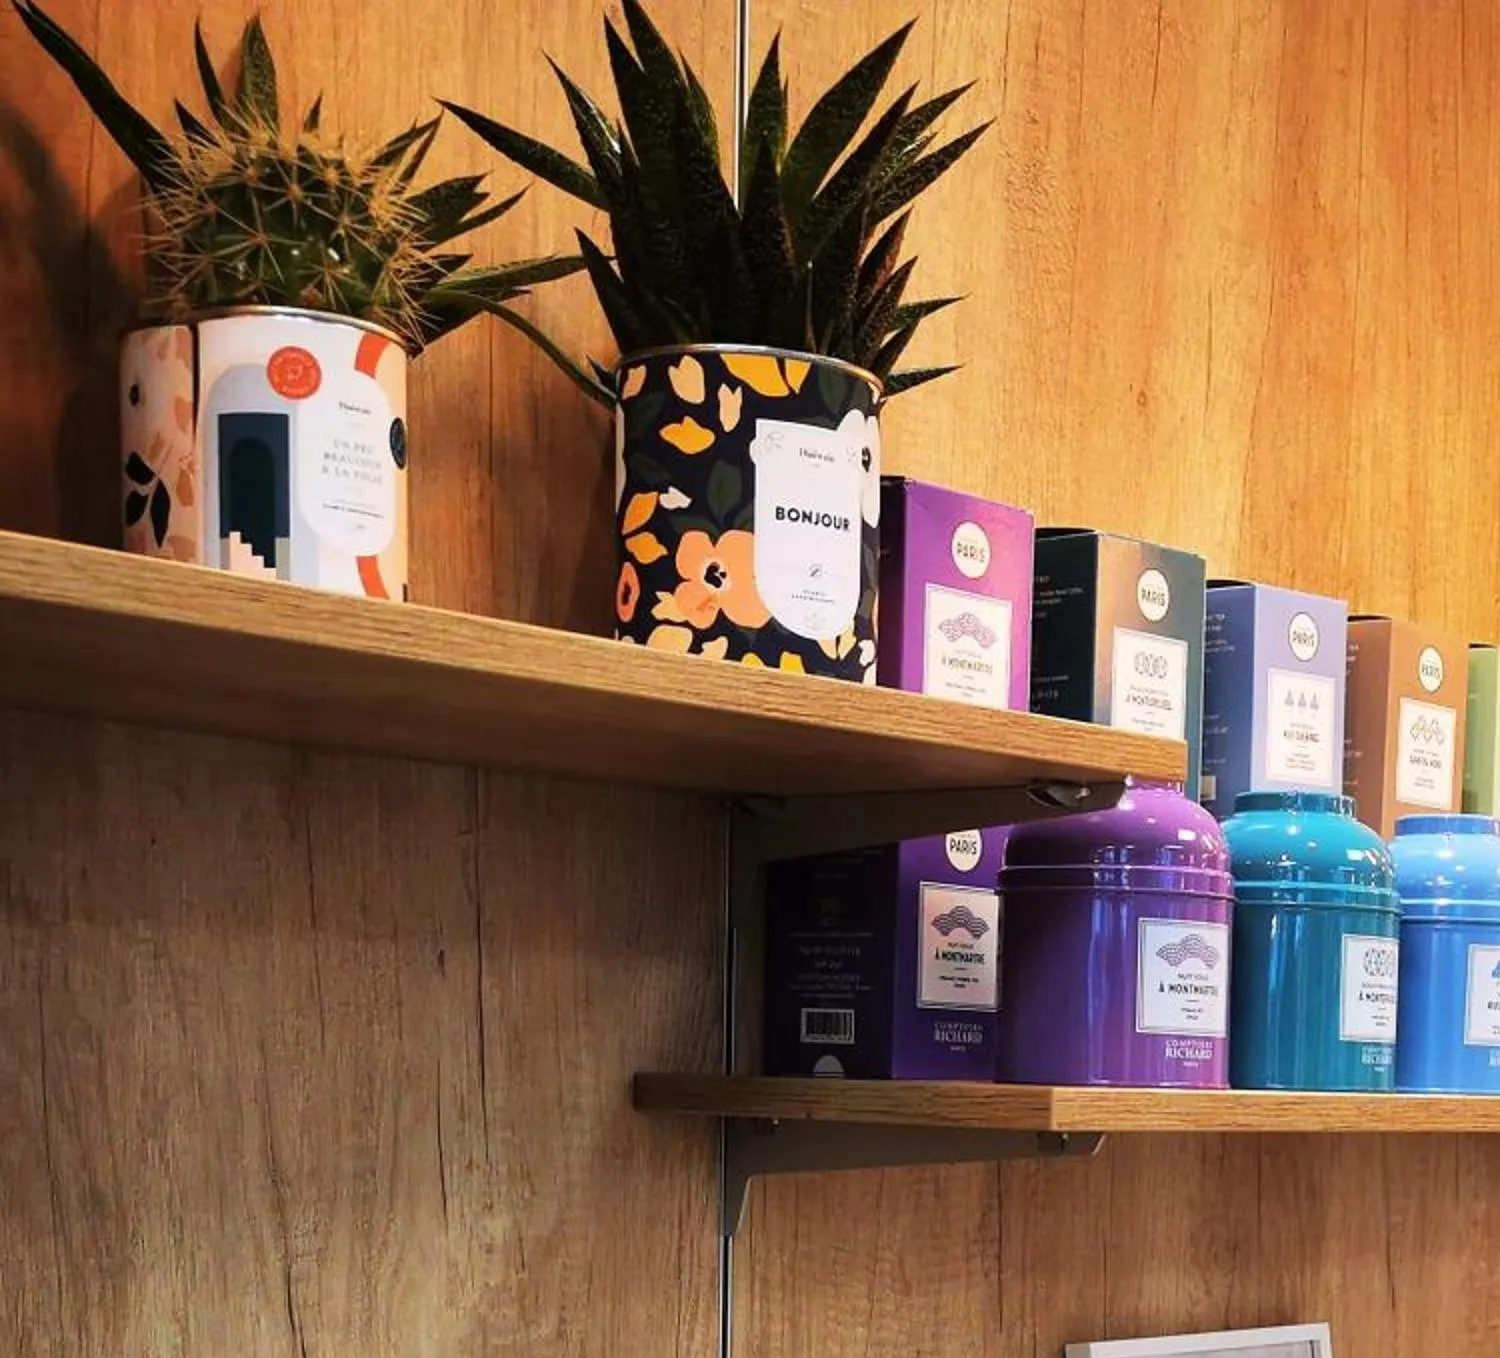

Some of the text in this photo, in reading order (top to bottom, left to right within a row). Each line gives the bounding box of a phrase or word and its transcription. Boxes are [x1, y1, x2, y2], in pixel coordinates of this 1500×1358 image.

[775, 506, 850, 531] BONJOUR
[957, 541, 985, 563] PARIS
[1140, 588, 1166, 607] PARIS
[1292, 630, 1315, 647] PARIS
[950, 839, 977, 855] PARIS
[942, 951, 986, 965] MONTMARTRE
[1168, 983, 1218, 997] MONTMARTRE
[934, 1029, 983, 1043] RICHARD
[1165, 1048, 1213, 1060] RICHARD
